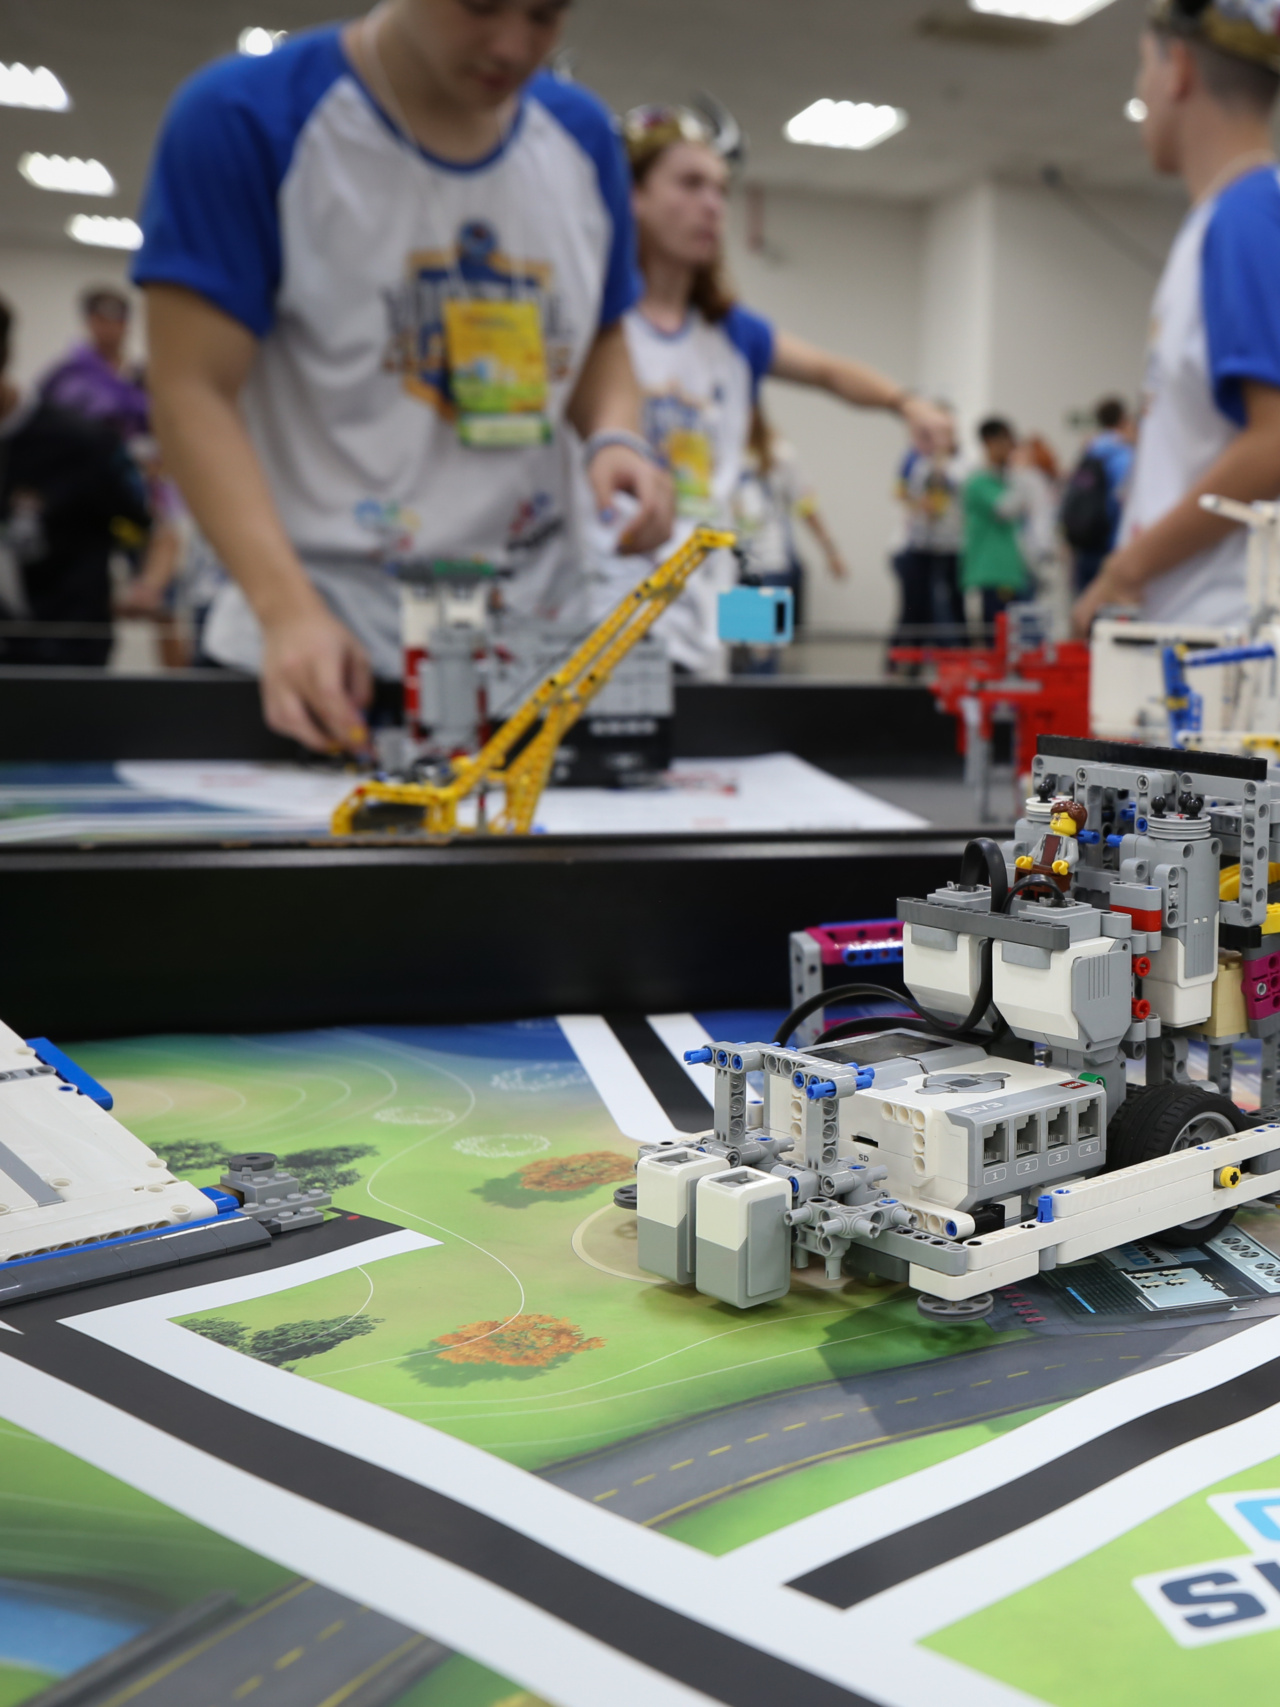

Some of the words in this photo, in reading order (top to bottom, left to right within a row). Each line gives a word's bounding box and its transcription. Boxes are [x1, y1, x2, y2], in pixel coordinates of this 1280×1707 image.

[961, 1102, 1004, 1114] EV3
[858, 1153, 869, 1162] SD
[1025, 1163, 1031, 1171] 2
[1055, 1154, 1062, 1162] 3
[1085, 1145, 1092, 1153] 4
